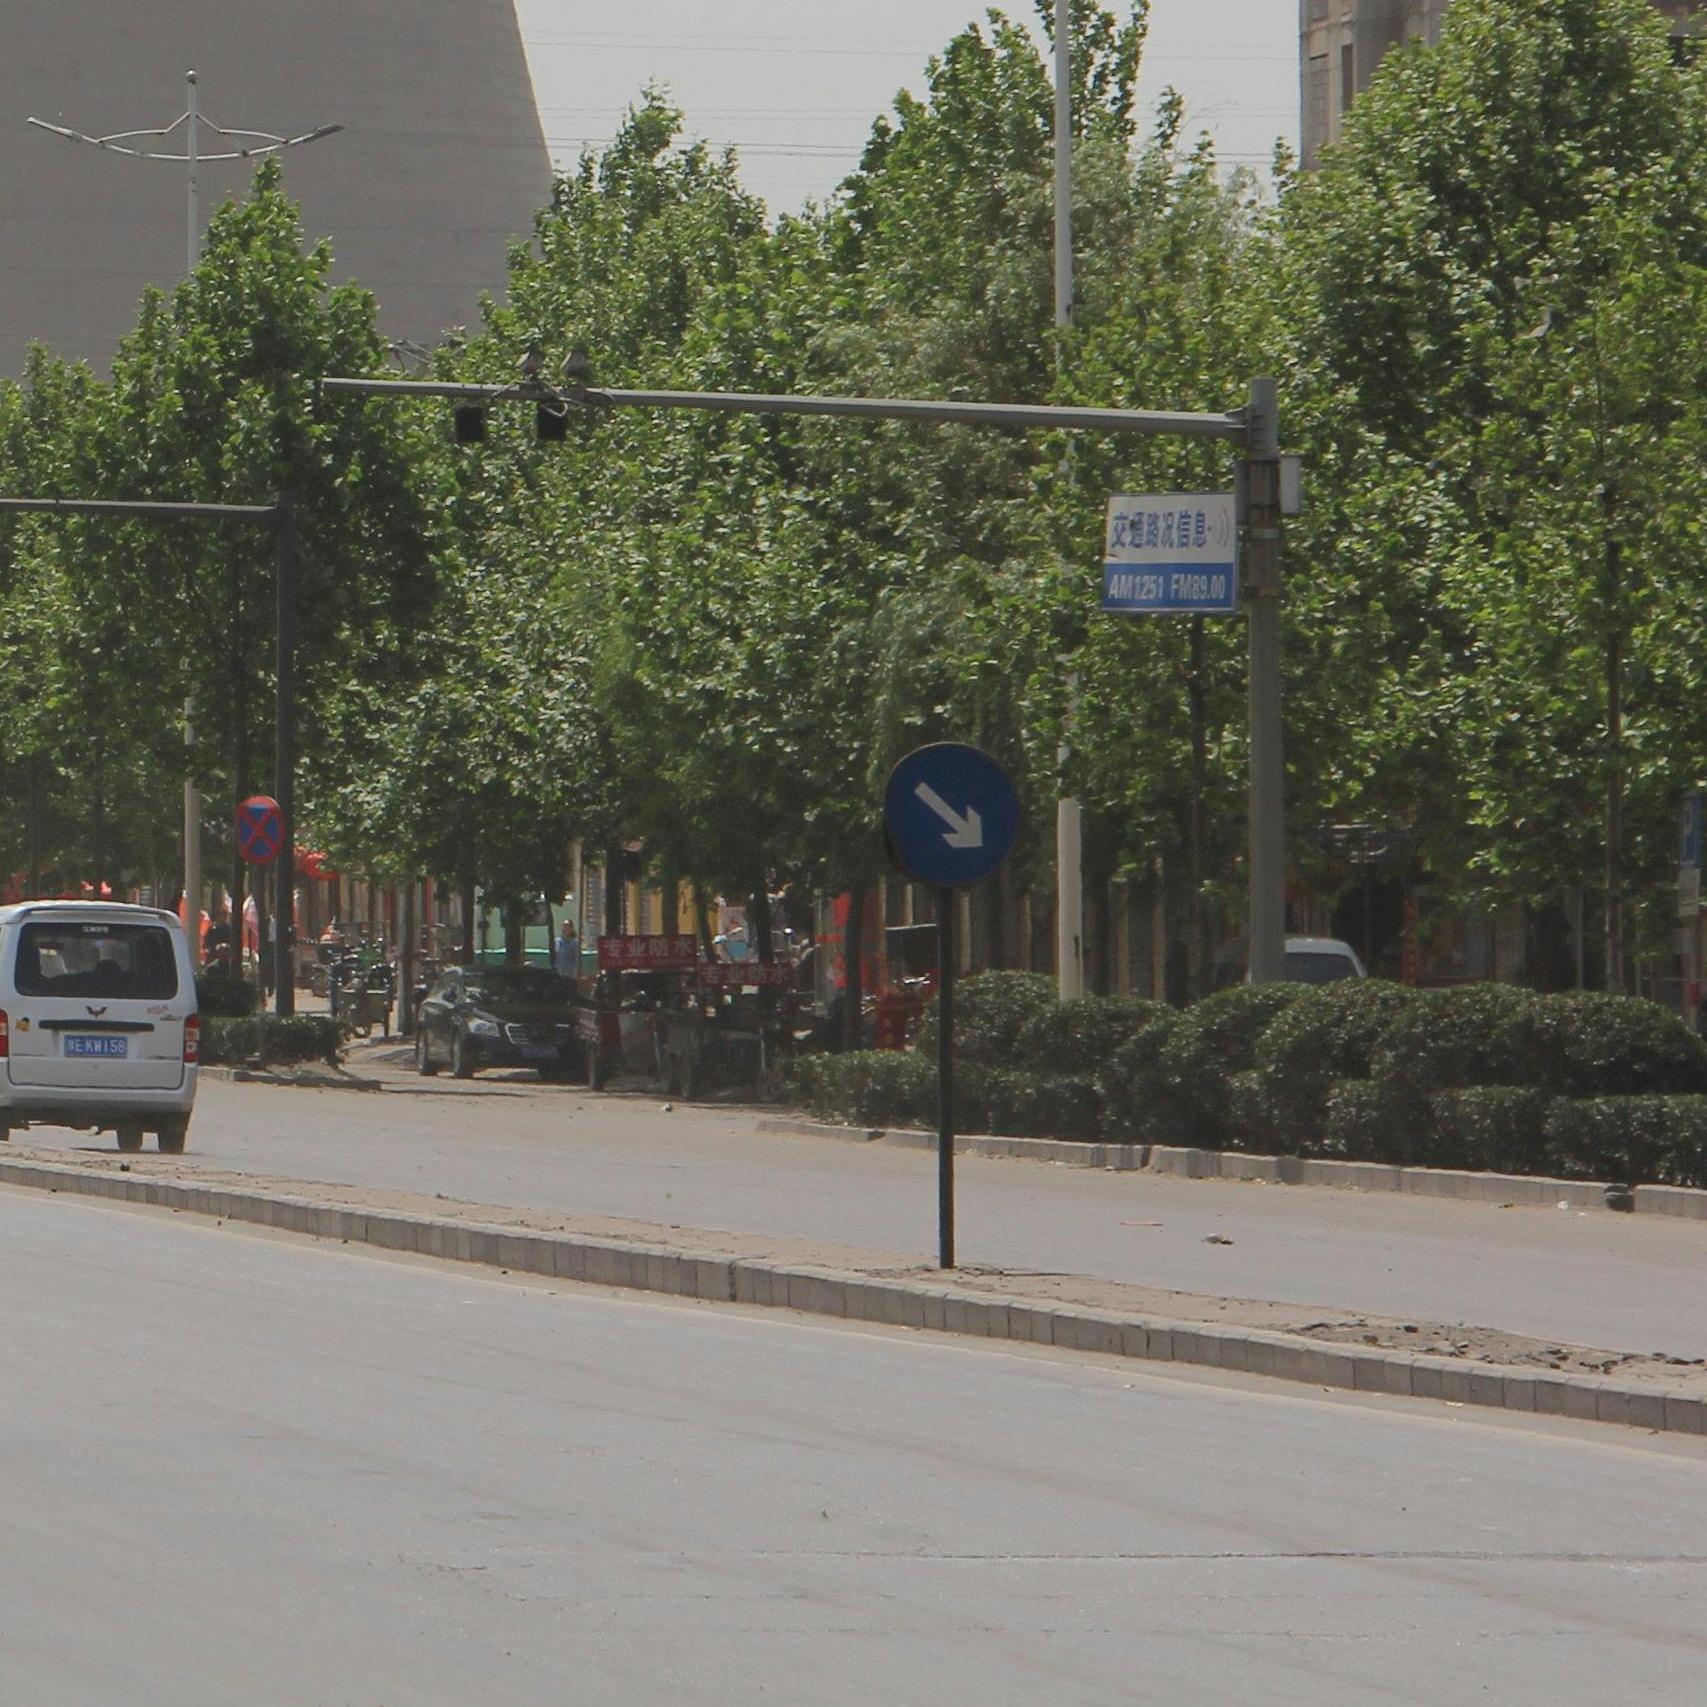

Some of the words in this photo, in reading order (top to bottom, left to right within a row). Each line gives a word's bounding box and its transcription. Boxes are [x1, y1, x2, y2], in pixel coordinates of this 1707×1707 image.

[1111, 510, 1206, 549] 交通路况信息
[605, 938, 692, 957] 专业防水
